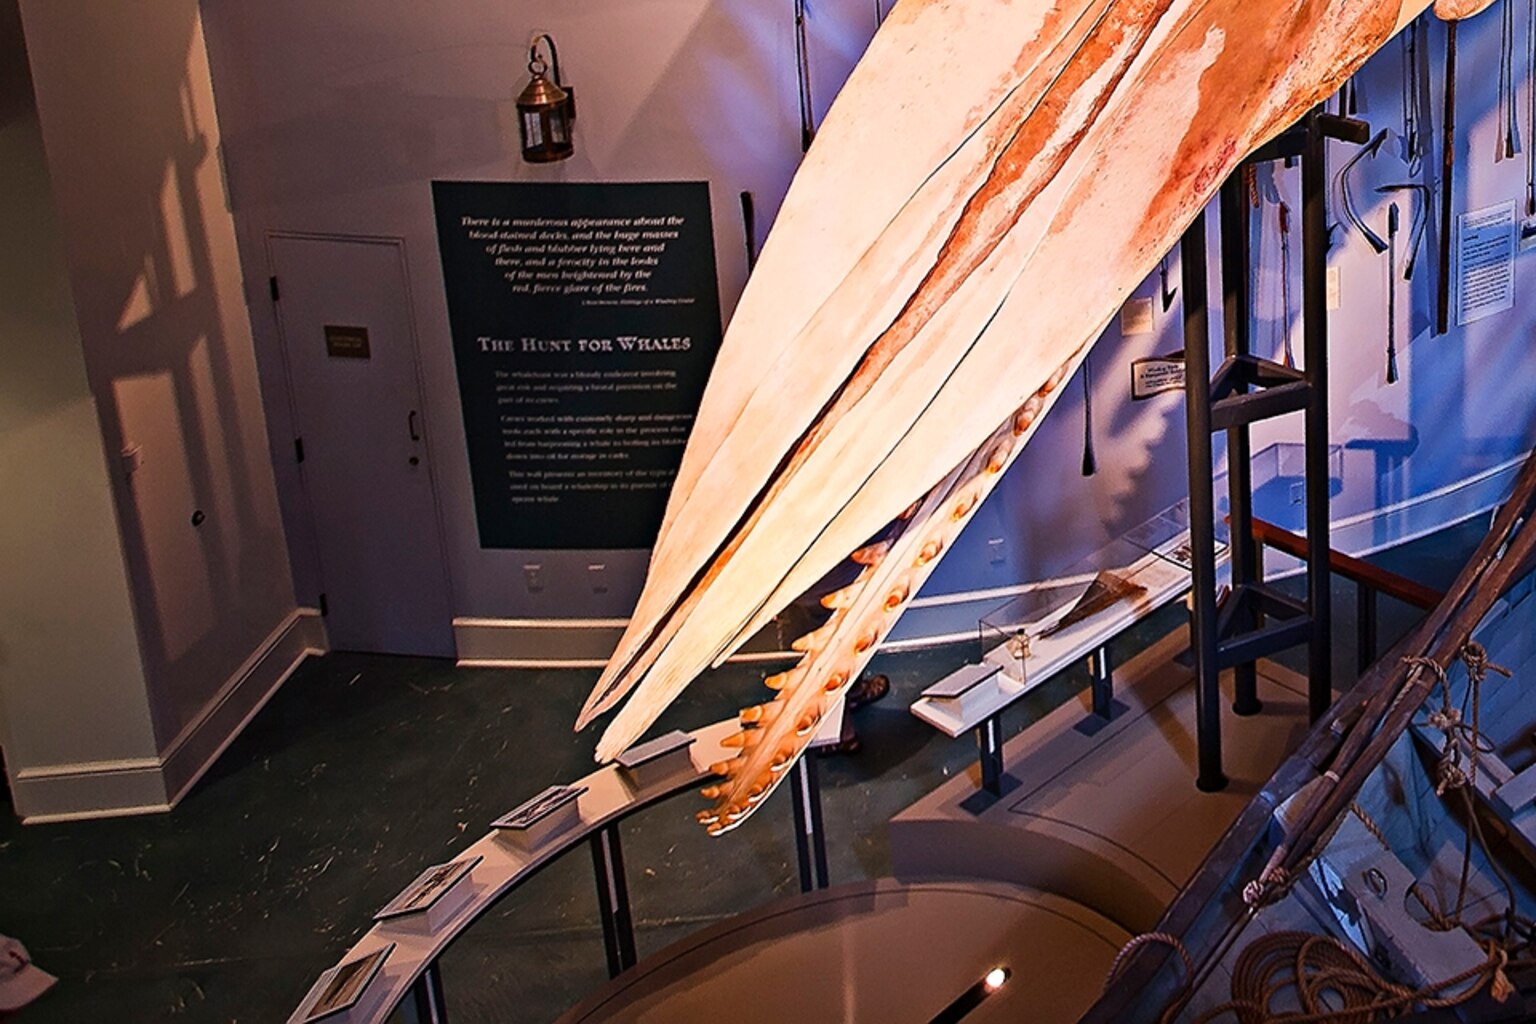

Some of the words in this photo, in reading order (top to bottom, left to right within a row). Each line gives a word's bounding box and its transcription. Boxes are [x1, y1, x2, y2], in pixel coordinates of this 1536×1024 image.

[461, 217, 489, 226] There
[492, 217, 499, 226] is
[502, 217, 510, 226] a
[513, 217, 568, 226] murderous
[571, 217, 631, 228] appearance
[633, 217, 665, 226] about
[667, 216, 684, 226] the
[572, 231, 593, 240] and
[595, 231, 612, 240] the
[613, 231, 640, 241] huge
[643, 231, 679, 240] masses
[485, 244, 497, 255] of
[524, 244, 546, 253] and
[547, 244, 588, 253] blubber
[590, 244, 616, 255] lying
[618, 244, 641, 253] here
[642, 243, 665, 253] and
[525, 257, 546, 266] and
[557, 257, 595, 269] ferocity
[598, 257, 609, 266] in
[612, 257, 629, 266] the
[630, 257, 658, 266] looks
[504, 271, 516, 281] of
[517, 271, 534, 279] the
[561, 271, 617, 281] heightened
[619, 271, 632, 281] by
[634, 271, 652, 279] the
[563, 285, 589, 295] glare
[591, 284, 604, 294] of
[605, 284, 622, 292] the
[477, 337, 515, 352] THE
[521, 337, 572, 352] HUNT
[578, 337, 613, 352] FOR
[616, 337, 691, 352] WHALES
